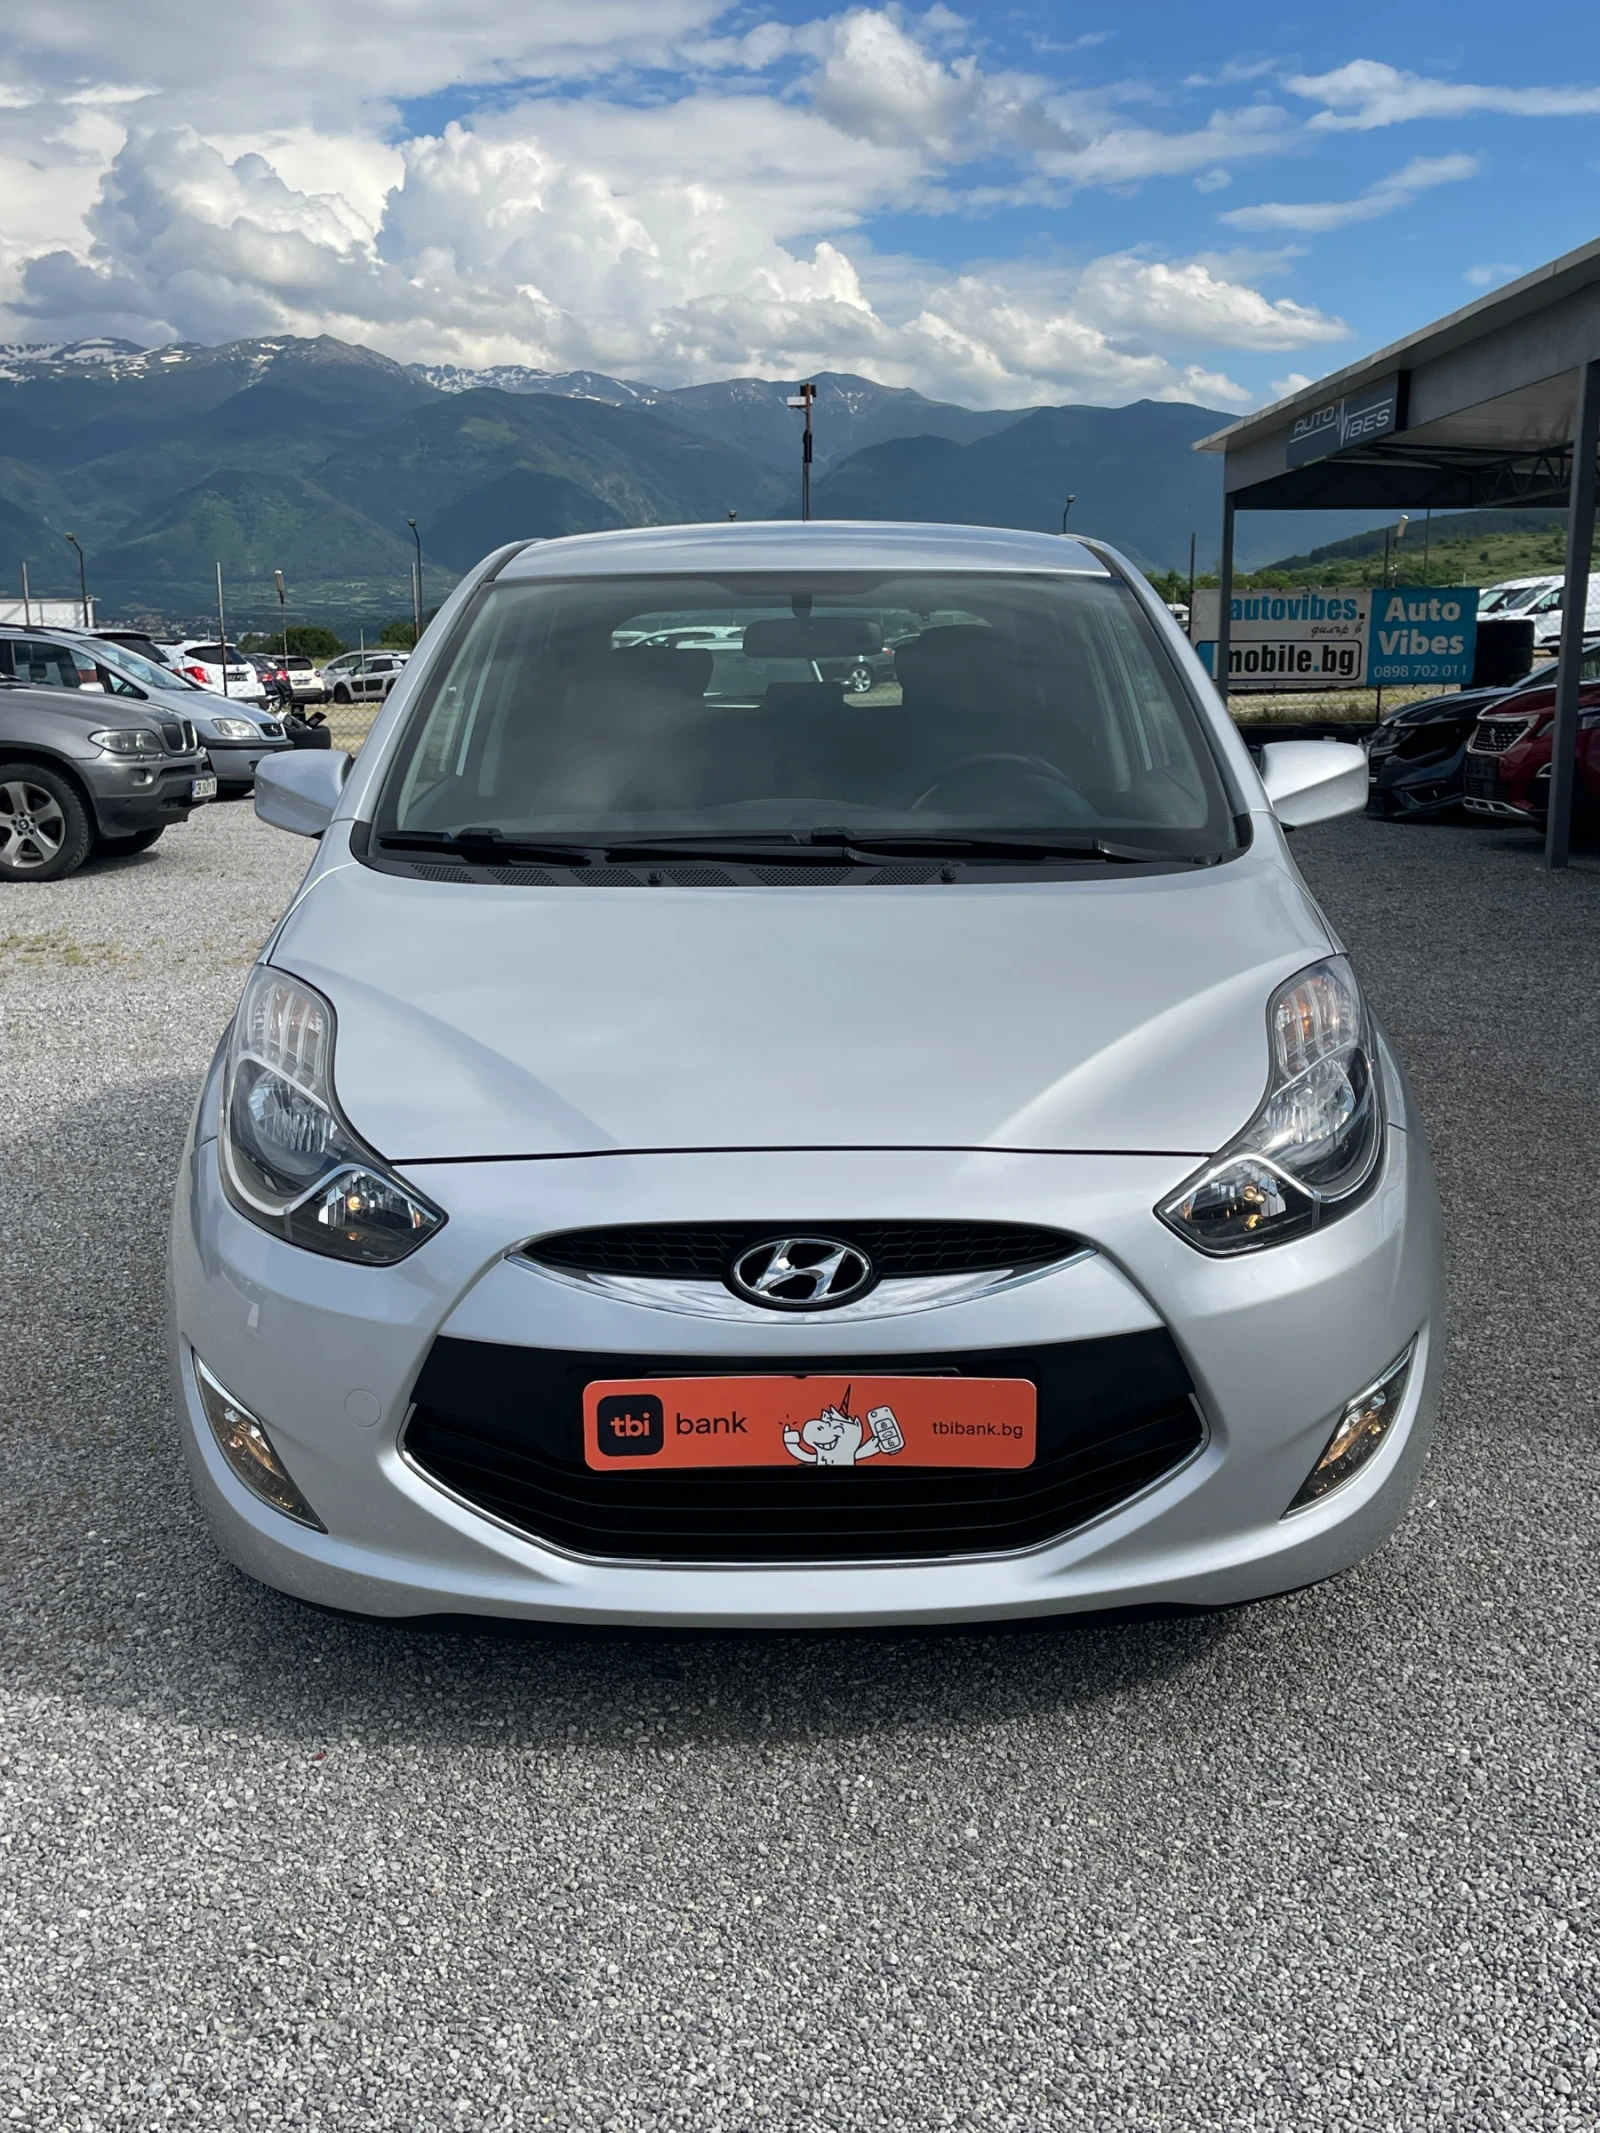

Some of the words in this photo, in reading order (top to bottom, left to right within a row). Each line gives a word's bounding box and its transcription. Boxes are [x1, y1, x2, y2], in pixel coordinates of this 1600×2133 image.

[1294, 406, 1335, 435] AUTO
[1384, 597, 1461, 622] Auto
[1378, 629, 1464, 655] Vibes
[1374, 665, 1409, 678] 0898
[1413, 665, 1439, 677] 702
[1442, 664, 1467, 677] 011
[610, 1412, 650, 1437] tbi
[676, 1411, 748, 1435] bank
[932, 1421, 1023, 1440] tbibank.bg
